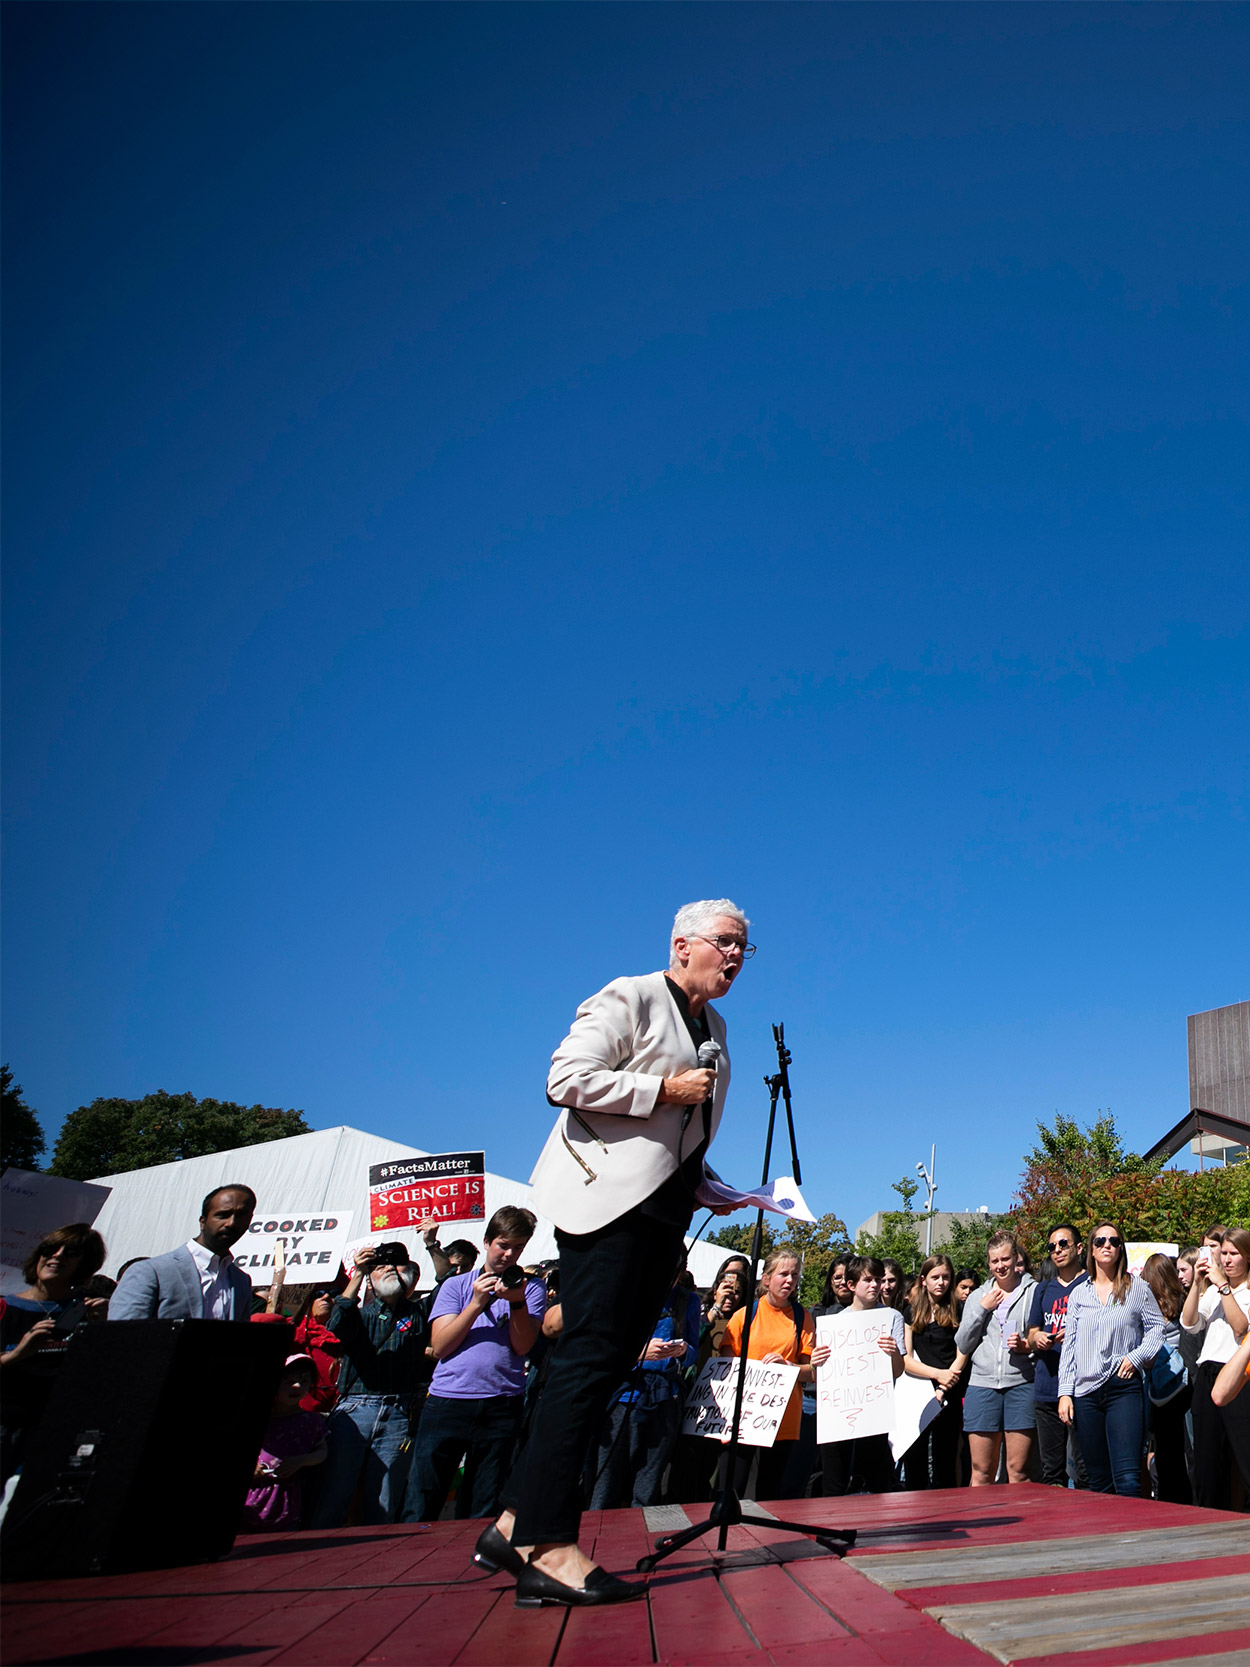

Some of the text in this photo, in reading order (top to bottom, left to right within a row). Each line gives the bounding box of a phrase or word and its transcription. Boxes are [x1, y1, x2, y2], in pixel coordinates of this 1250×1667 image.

[380, 1159, 471, 1177] #FactsMatter
[374, 1177, 415, 1193] CLIMATE
[378, 1181, 480, 1206] SCIENCE IS
[407, 1202, 456, 1221] REAL!
[248, 1218, 338, 1234] COOKED
[820, 1323, 887, 1350] DISCLOSE
[703, 1361, 740, 1382] STOP
[821, 1351, 880, 1382] DIVEST
[692, 1384, 711, 1400] ING
[820, 1381, 892, 1408] REINVEST
[752, 1415, 778, 1430] OUR
